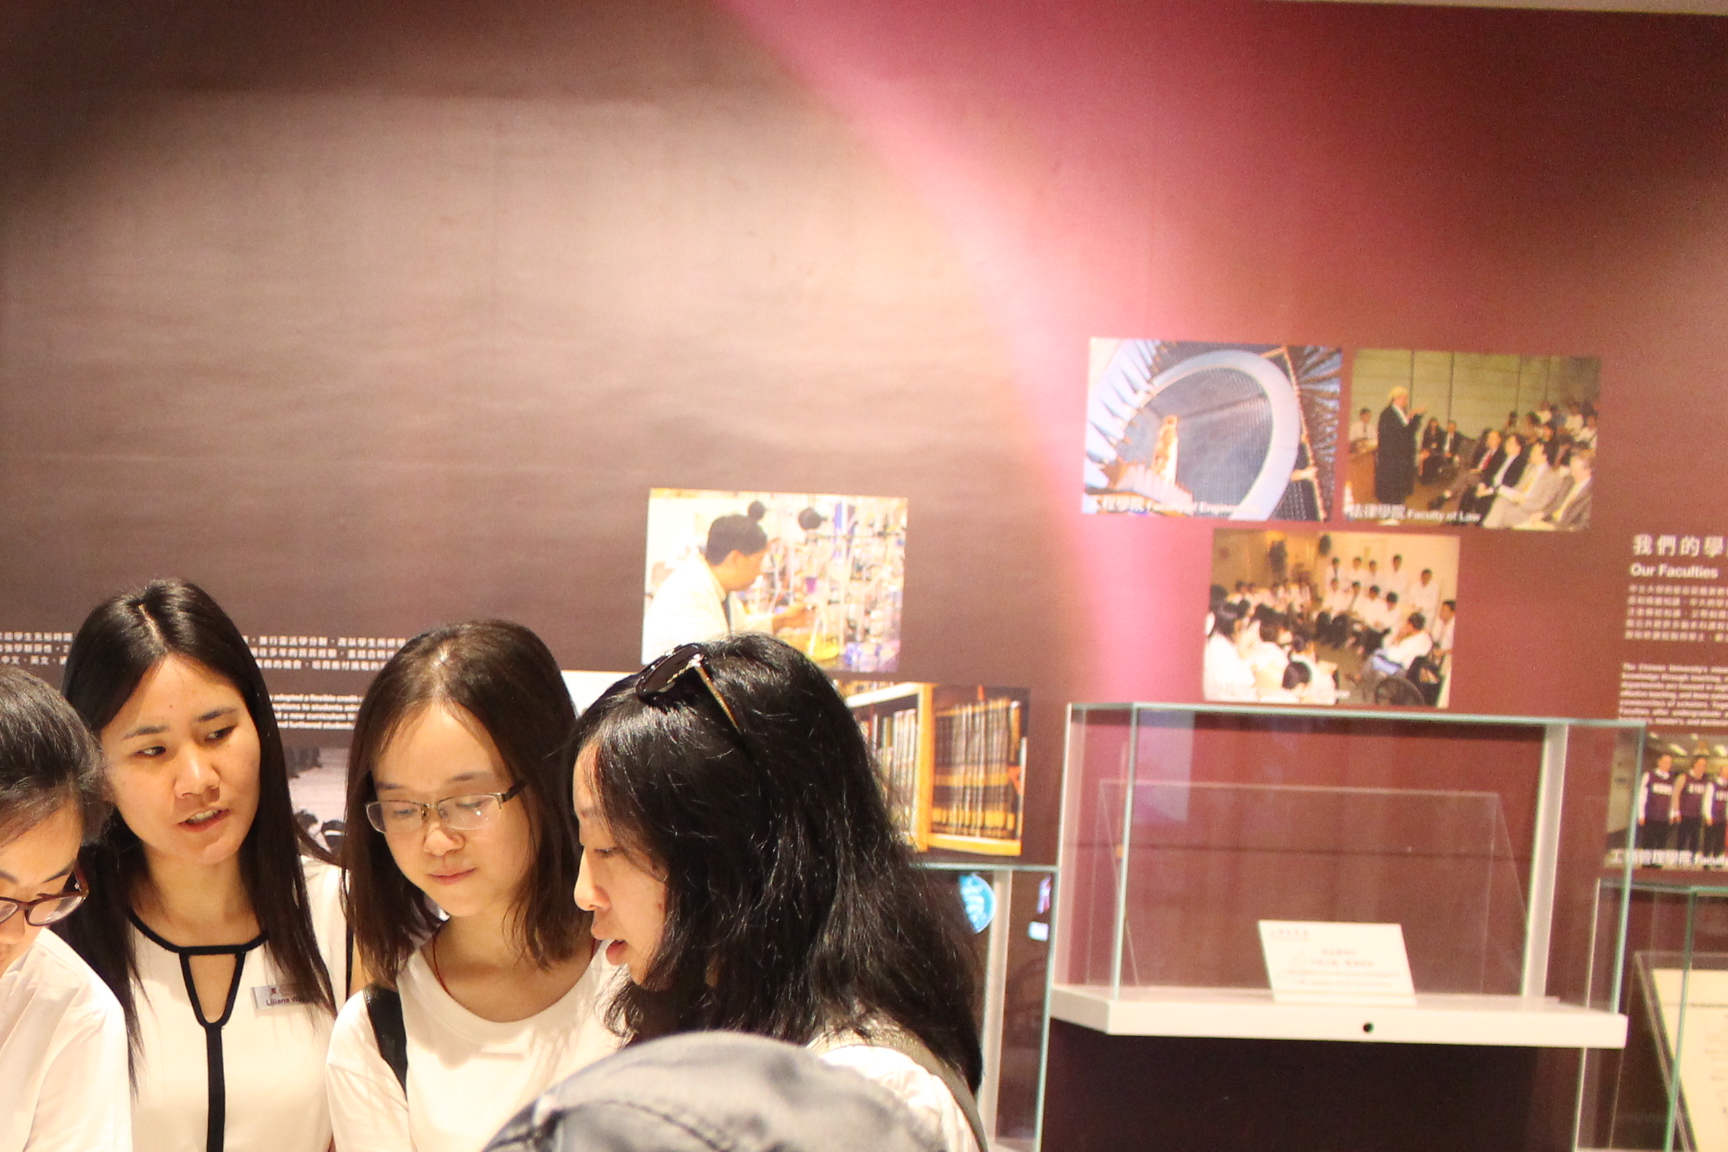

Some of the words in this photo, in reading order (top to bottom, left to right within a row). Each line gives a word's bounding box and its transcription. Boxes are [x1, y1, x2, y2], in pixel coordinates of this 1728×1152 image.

[1633, 532, 1728, 558] 我們的學
[1630, 562, 1657, 577] Our
[1657, 563, 1719, 579] Faculties
